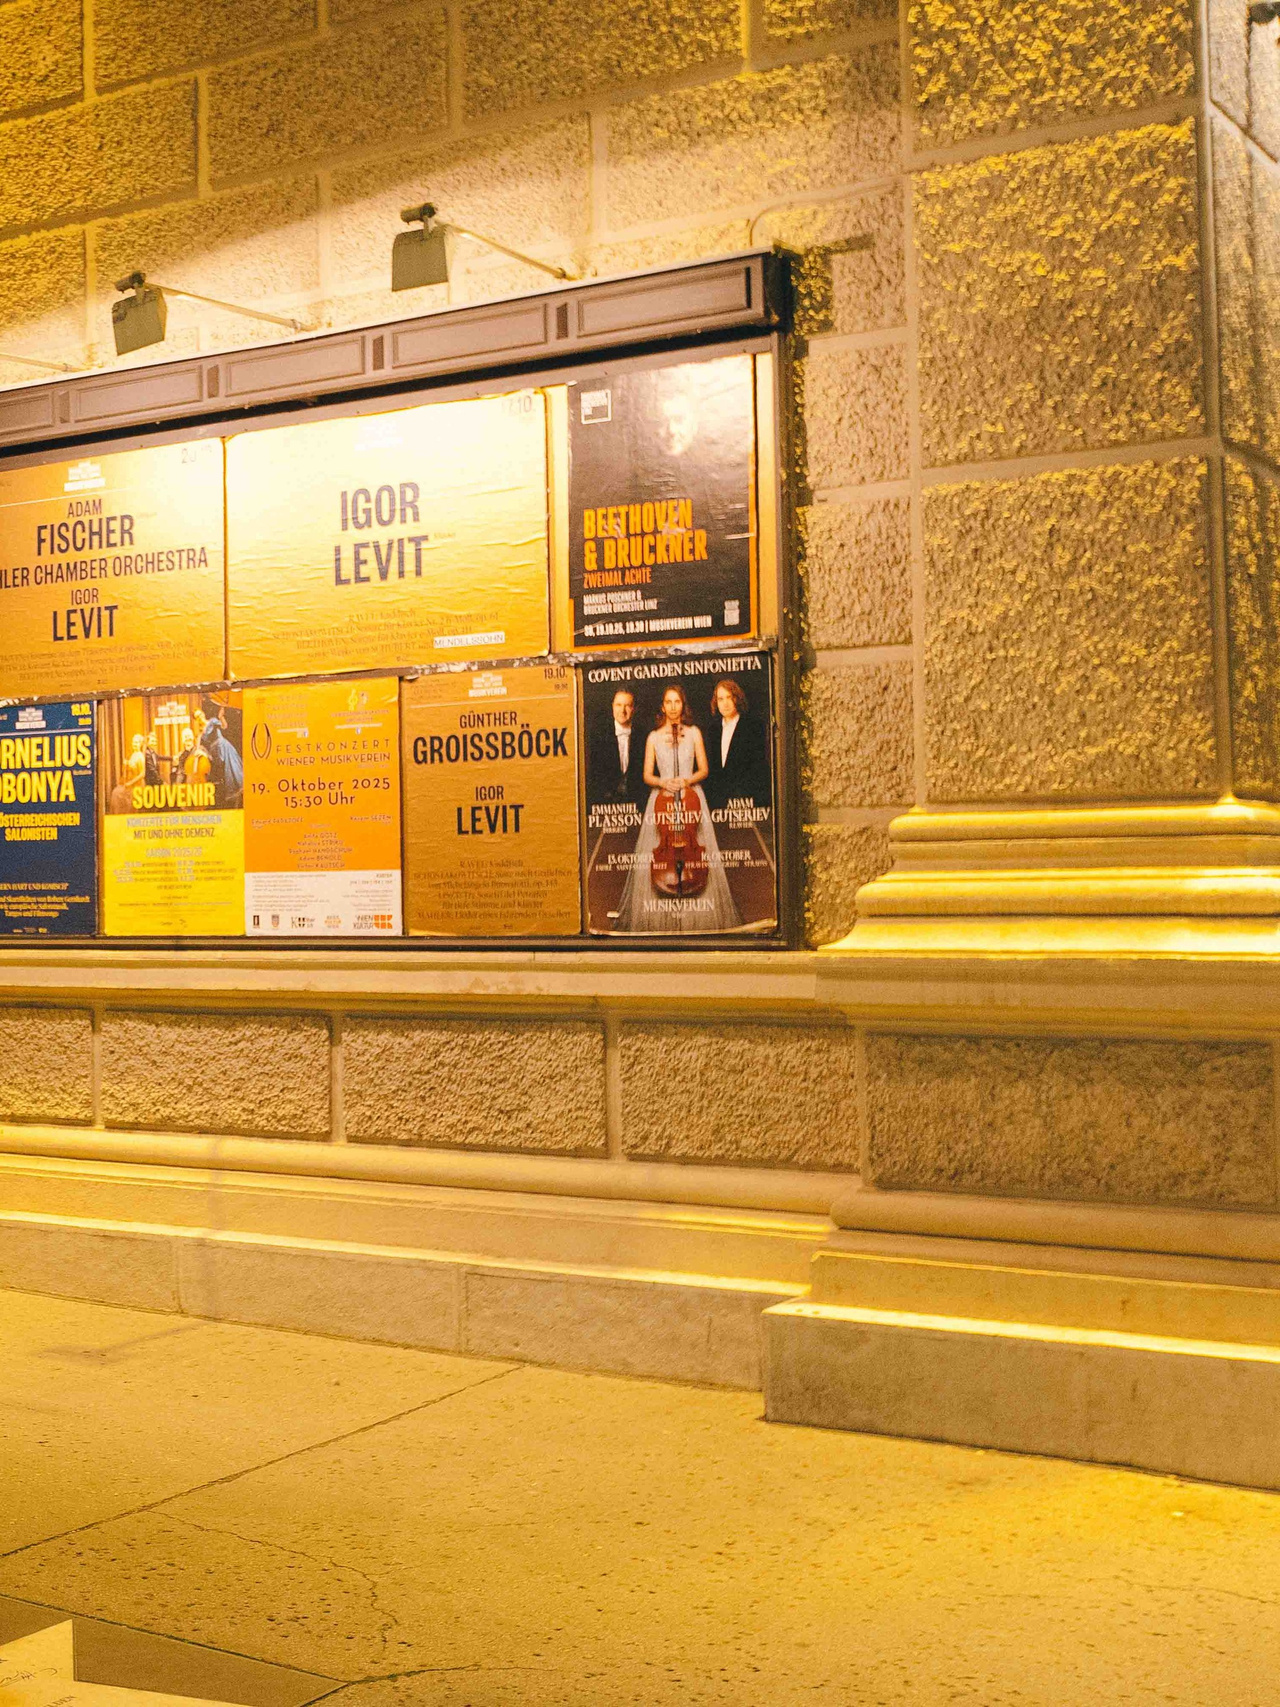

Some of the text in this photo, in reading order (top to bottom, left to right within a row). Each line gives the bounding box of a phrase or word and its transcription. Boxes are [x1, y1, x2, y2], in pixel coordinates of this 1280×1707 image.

[67, 498, 103, 518] ADAM
[340, 482, 420, 532] IGOR
[583, 498, 693, 540] BEETHOVEN
[36, 513, 135, 557] FISCHER
[584, 528, 708, 571] & BRUCKNER
[34, 555, 108, 585] CHAMBER
[112, 546, 209, 577] ORCHESTRA
[333, 534, 429, 587] LEVIT
[583, 567, 652, 589] ZWEIMAL ACHTE
[70, 587, 99, 605] IGOR
[52, 604, 118, 642] LEVIT
[434, 632, 504, 649] MENDELSSOHN
[543, 666, 568, 680] 19.10.
[588, 655, 763, 684] COVENT GARDEN SINFONIETTA
[459, 709, 519, 729] GÜNTHER
[412, 722, 569, 766] GROISSBÖCK
[276, 752, 391, 768] WIENER MUSIKVEREIN
[251, 776, 391, 795] 19. Oktober 2025
[474, 784, 505, 801] IGOR
[132, 781, 217, 810] SOUVENIR
[283, 791, 357, 809] 15:30 Uhr
[726, 798, 755, 810] ADAM
[591, 803, 639, 815] EMMANUEL
[711, 806, 771, 824] GUTSERIEV
[456, 803, 525, 836] LEVIT
[588, 813, 643, 828] PLASSON
[4, 827, 59, 841] SALONISTEN
[133, 826, 216, 840] MIT UND OHNE DEMENZ
[643, 897, 715, 914] MUSIKVEREIN
